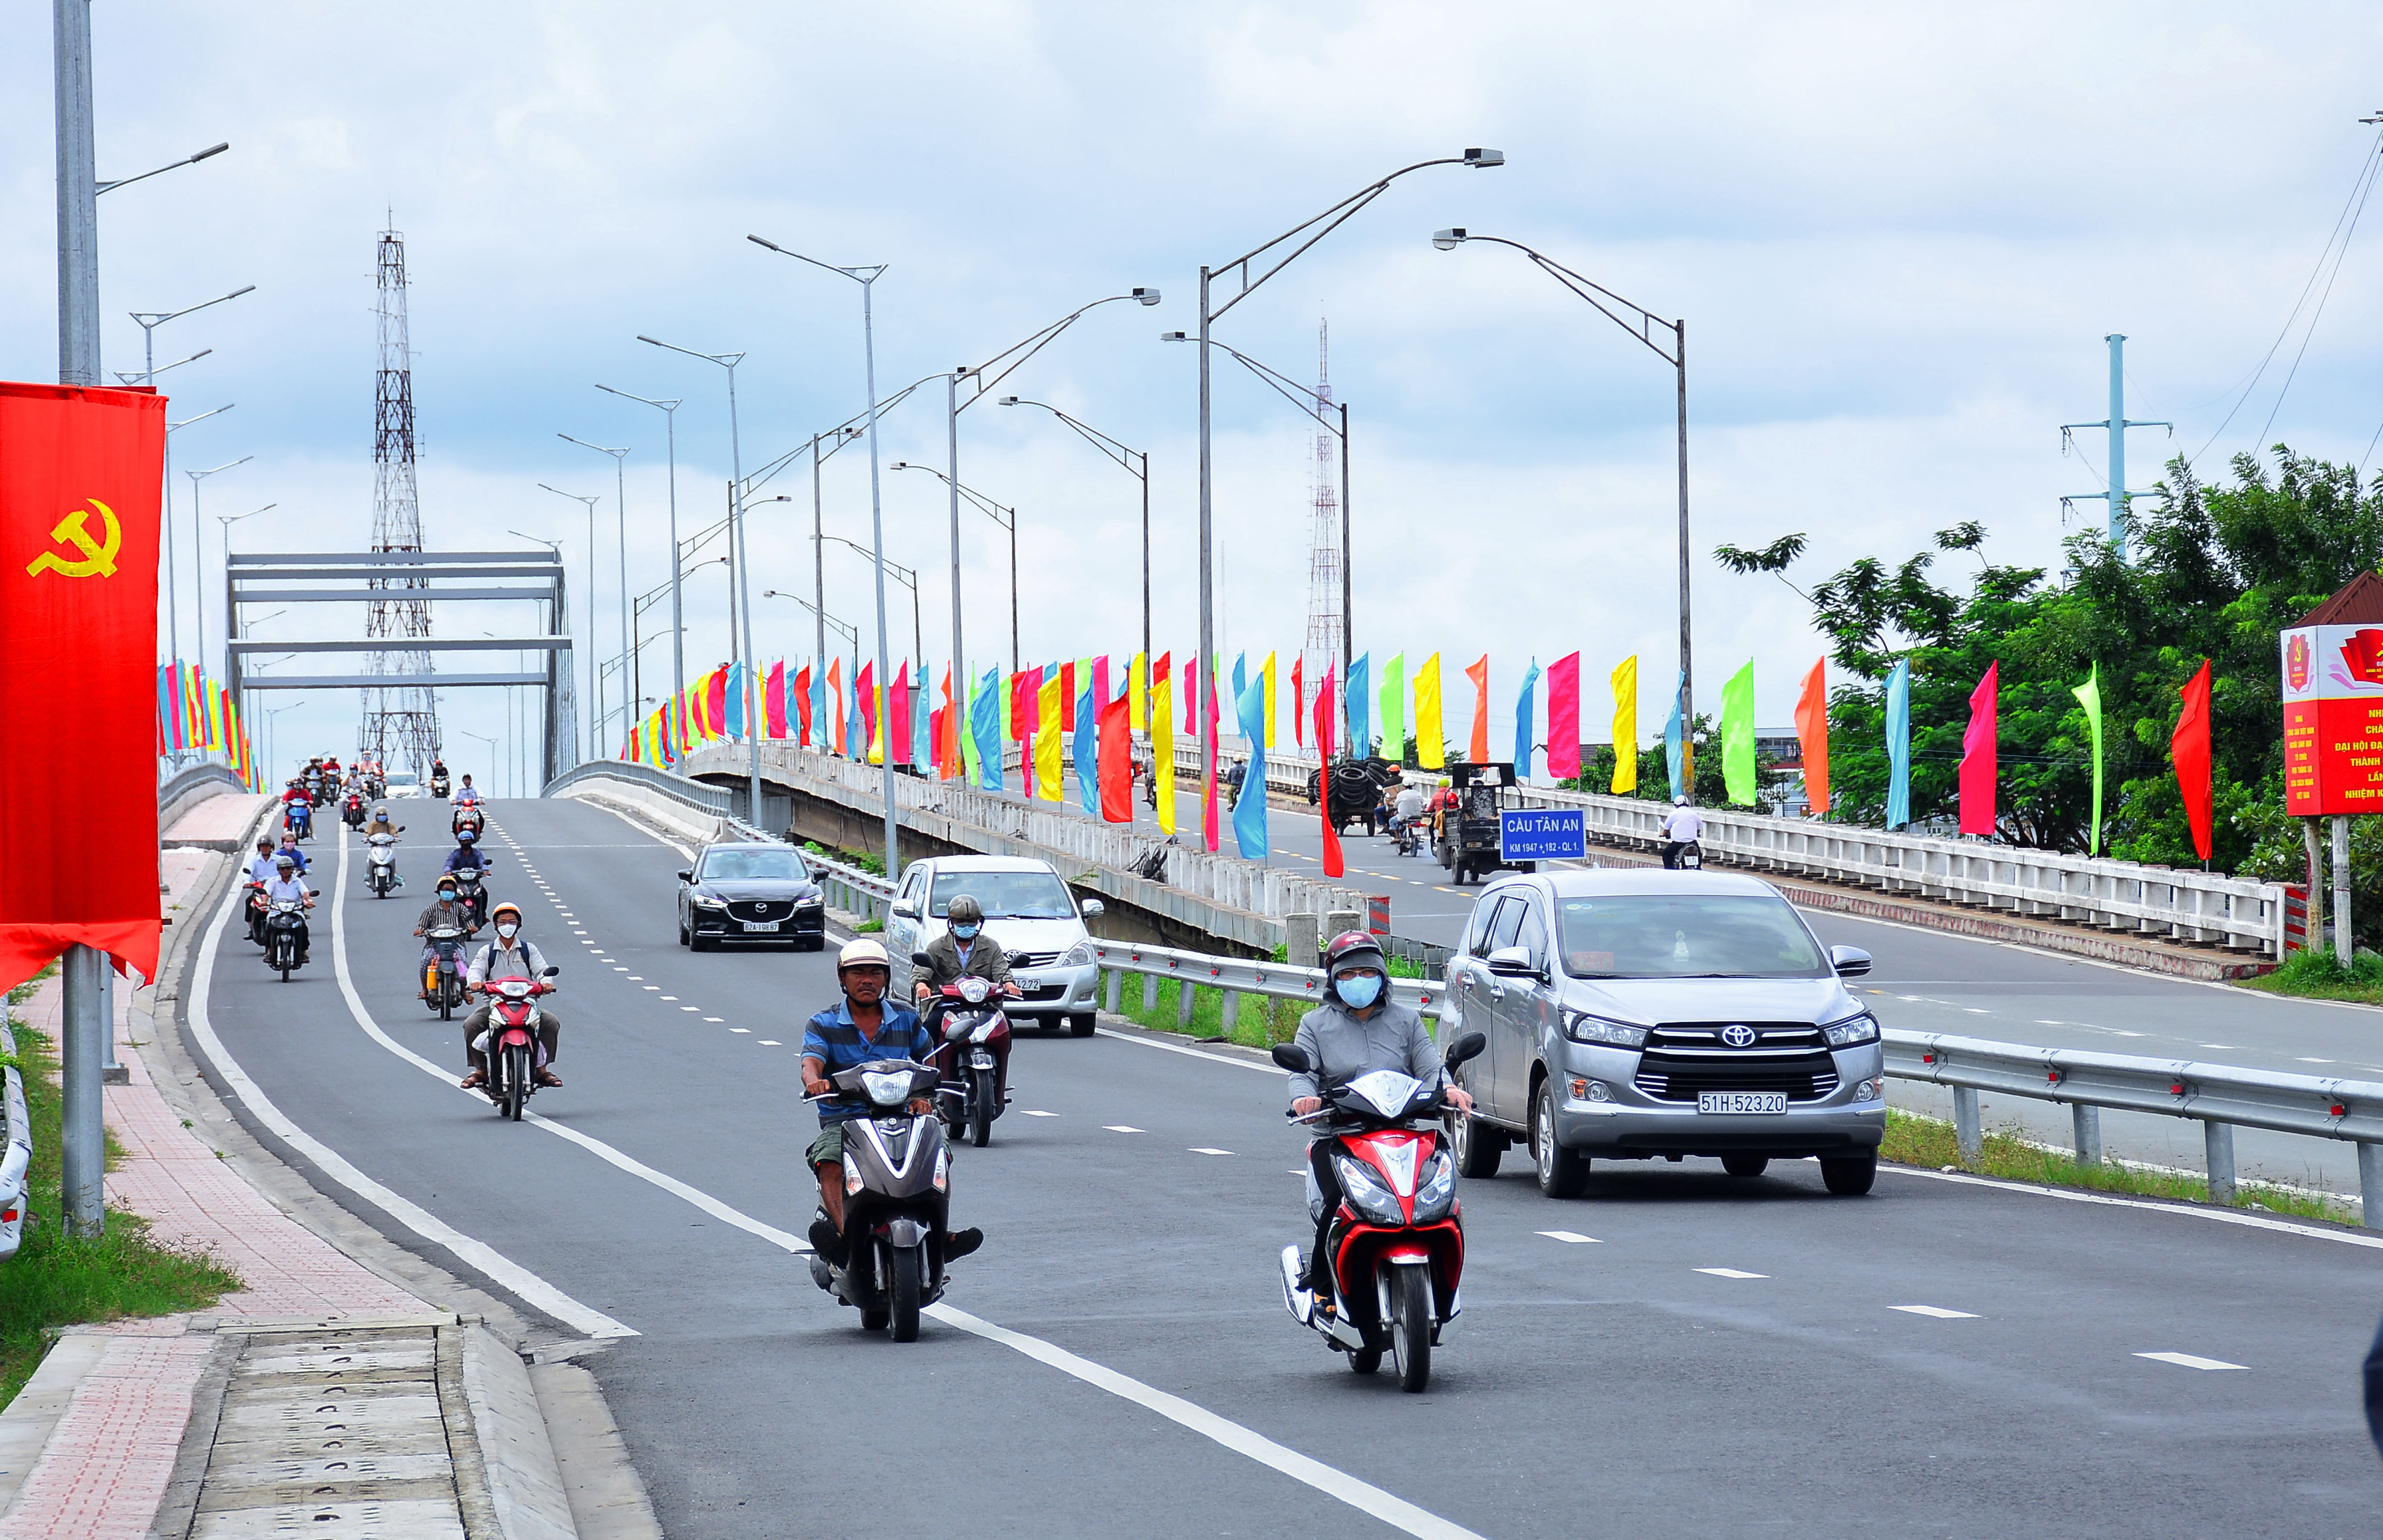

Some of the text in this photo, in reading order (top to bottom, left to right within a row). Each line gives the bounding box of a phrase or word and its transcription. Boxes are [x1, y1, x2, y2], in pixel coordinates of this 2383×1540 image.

[2335, 742, 2350, 753] ĐẠI
[2352, 740, 2368, 751] HỘI
[2350, 755, 2380, 767] THÀNH
[2345, 788, 2375, 800] NHIỆM
[1535, 816, 1559, 832] TÂN
[1562, 819, 1578, 831] AN
[1509, 842, 1521, 852] KM
[1522, 842, 1538, 852] 1947
[1545, 842, 1557, 851] 182
[1562, 842, 1572, 851] QL
[1701, 1095, 1784, 1112] 51H-523.20
